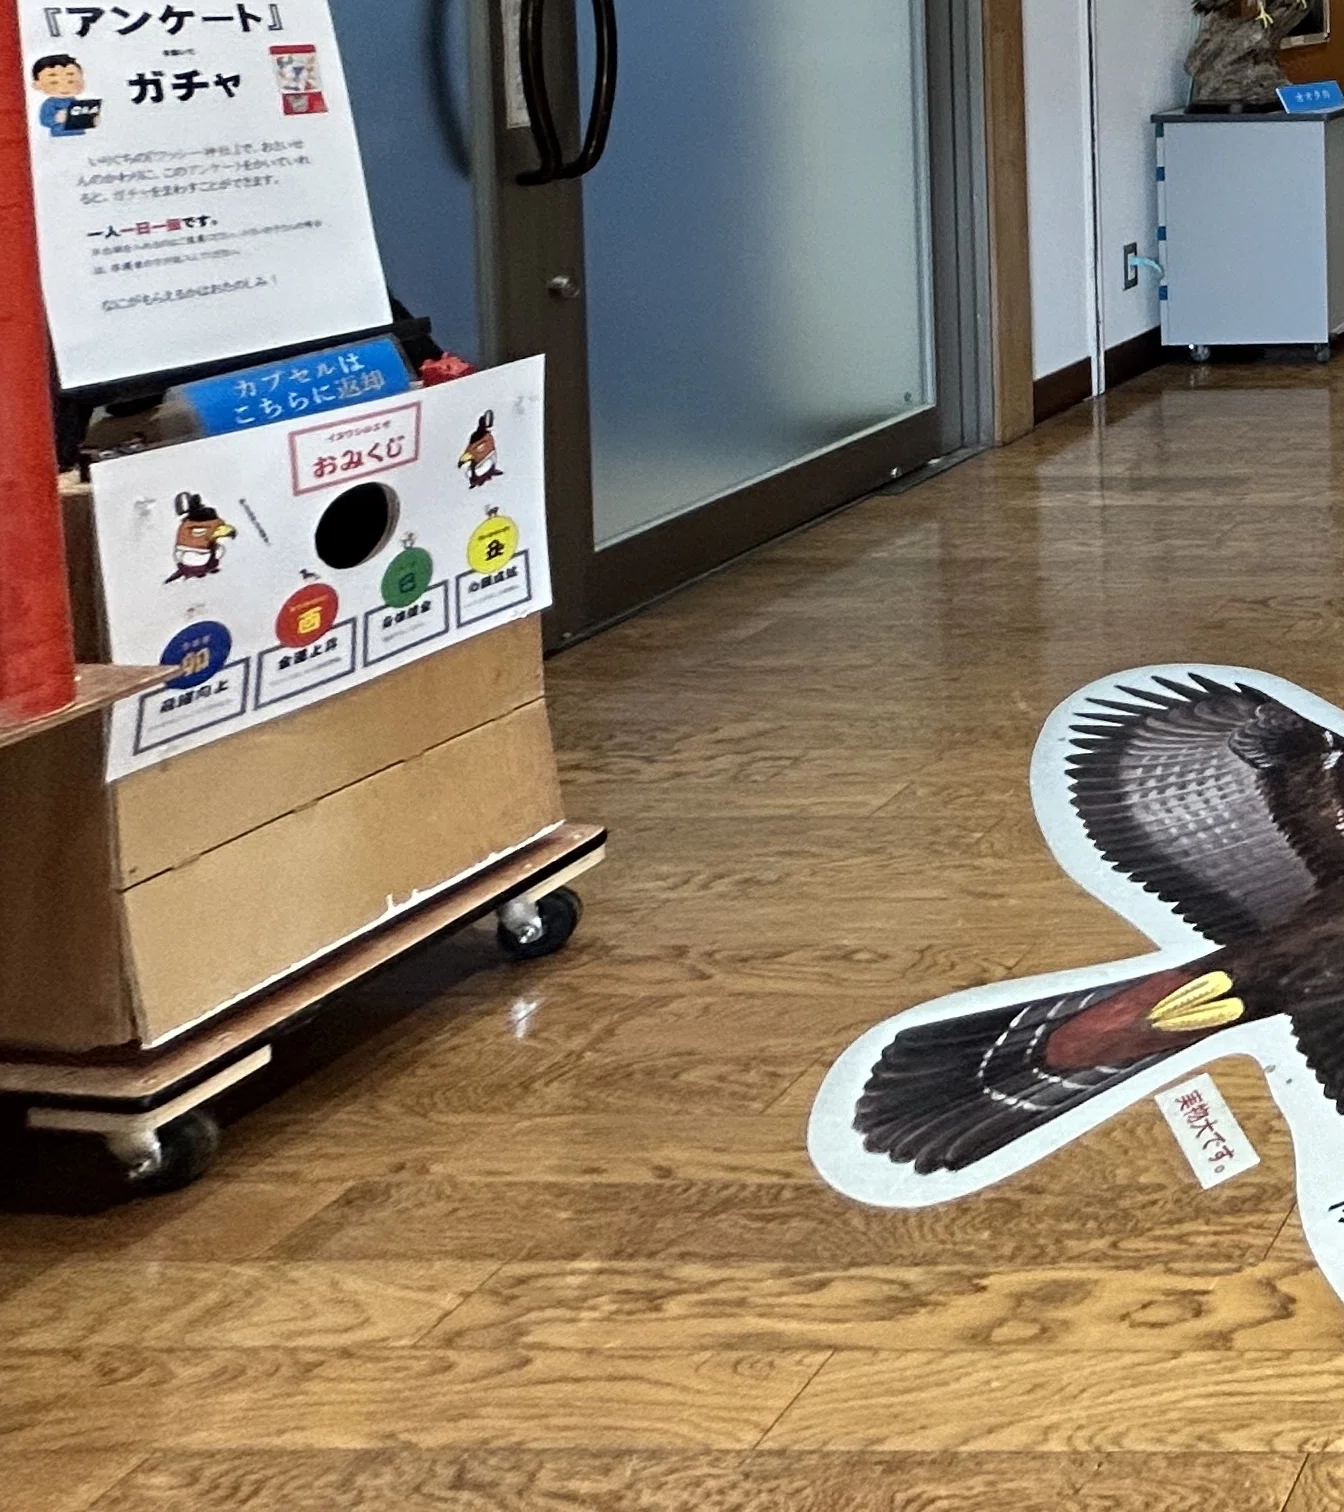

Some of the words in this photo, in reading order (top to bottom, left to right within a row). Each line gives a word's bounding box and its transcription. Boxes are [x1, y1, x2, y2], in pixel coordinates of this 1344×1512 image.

[42, 2, 284, 38] 『アンケート』
[126, 70, 241, 104] ガチャ
[233, 353, 365, 395] カプセルは
[233, 374, 386, 424] こちらに返却
[313, 434, 406, 478] おみくじ
[1174, 1088, 1238, 1176] 実物大です。
